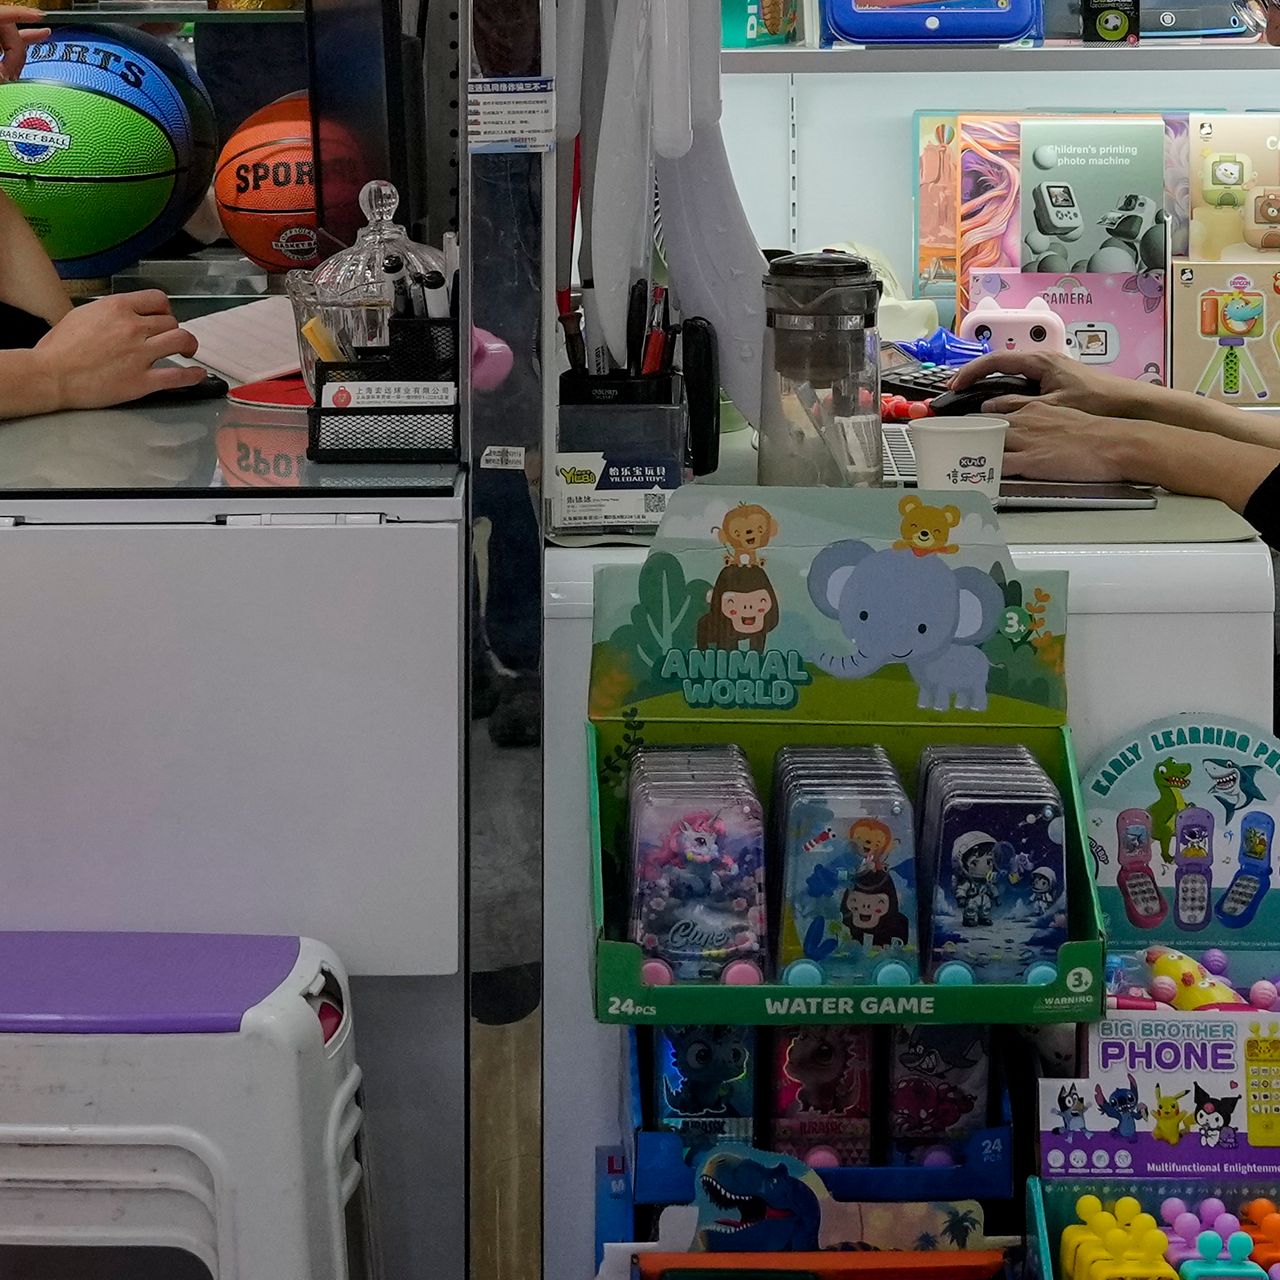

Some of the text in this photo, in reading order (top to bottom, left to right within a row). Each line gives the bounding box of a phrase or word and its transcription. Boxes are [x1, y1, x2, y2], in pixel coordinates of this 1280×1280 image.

[27, 42, 145, 88] ORTS
[1099, 144, 1138, 157] printing
[1057, 156, 1130, 166] photo machine
[1042, 291, 1093, 305] CAMERA
[609, 467, 666, 476] 怡乐宝玩具
[1004, 613, 1026, 635] 3+
[661, 649, 808, 680] ANIMAL
[684, 679, 795, 706] WORLD
[1091, 743, 1143, 797] EARLY
[1150, 726, 1251, 752] LEARNING
[1071, 972, 1089, 990] 3+
[765, 997, 854, 1017] WATER
[860, 997, 935, 1017] GAME
[1044, 995, 1094, 1006] WARNING
[1100, 1022, 1236, 1038] BIG BROTHER
[1100, 1040, 1237, 1070] PHONE
[981, 1138, 1003, 1154] 24
[1147, 1162, 1220, 1173] Multifunctional
